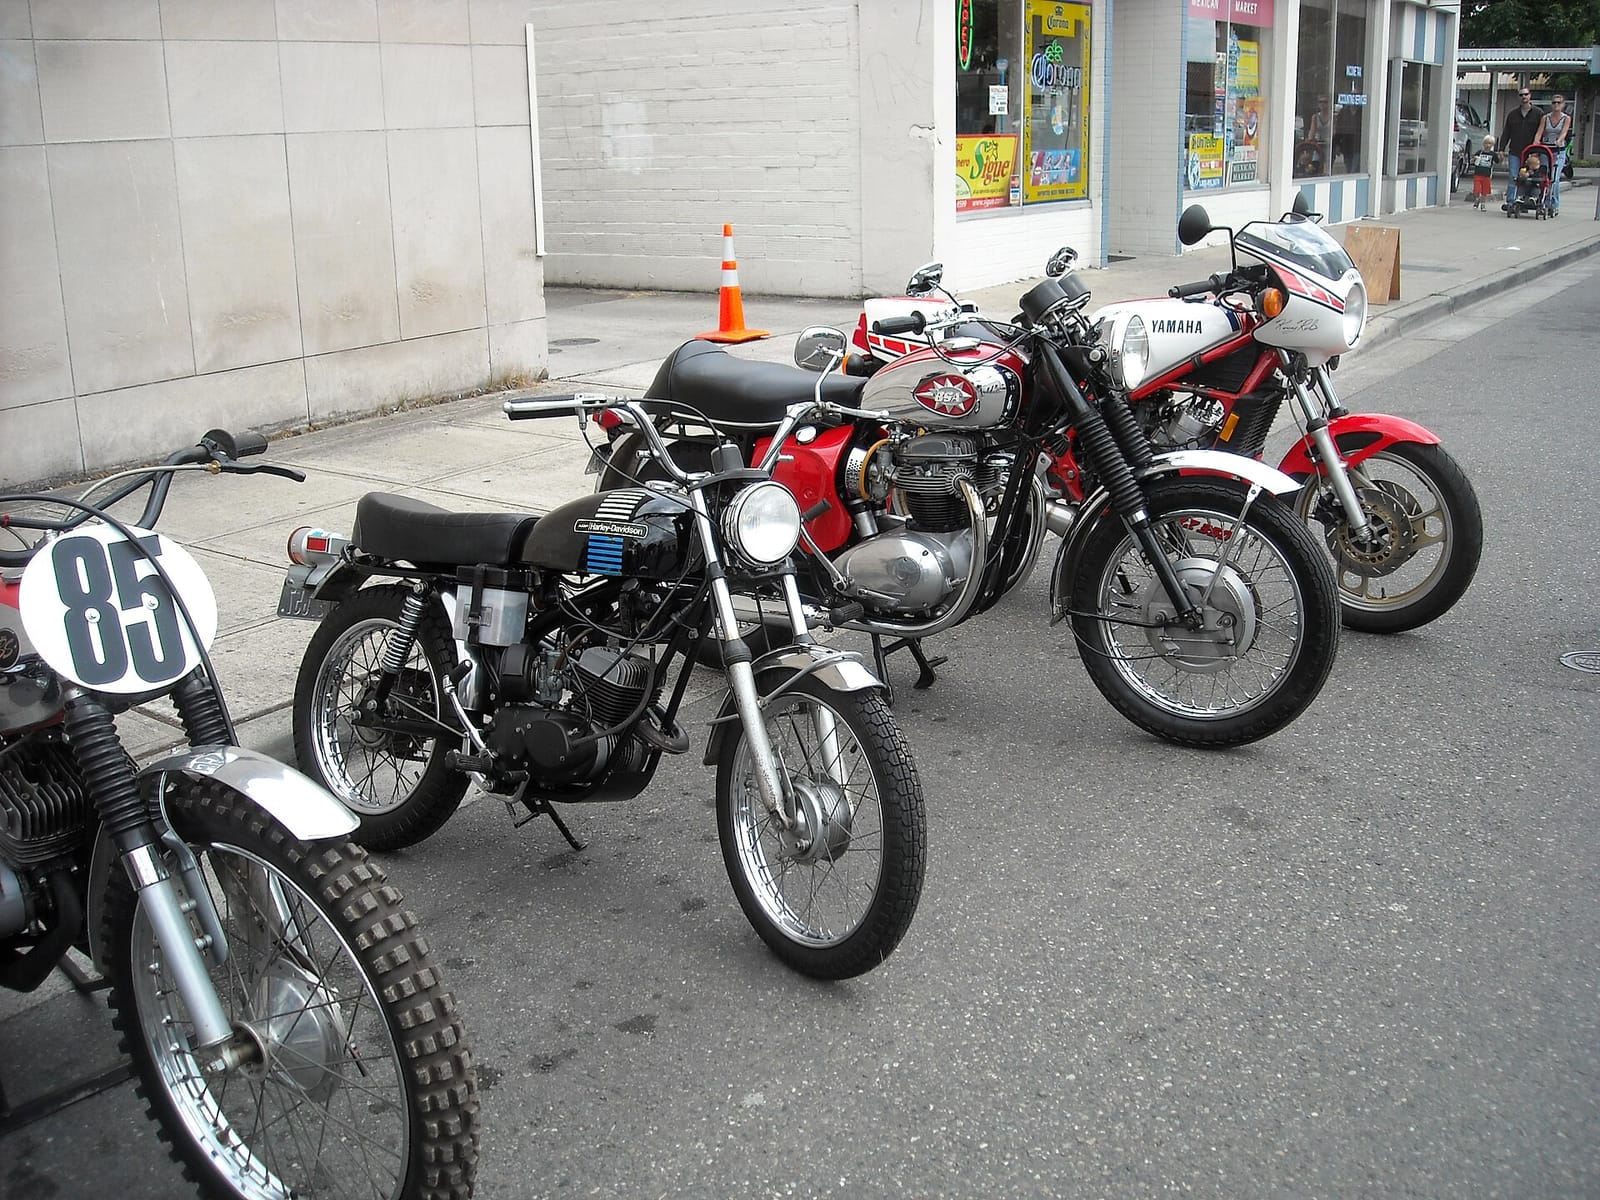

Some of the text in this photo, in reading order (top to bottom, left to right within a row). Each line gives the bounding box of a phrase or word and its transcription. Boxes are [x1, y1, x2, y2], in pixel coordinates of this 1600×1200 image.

[1235, 1, 1258, 15] MARKET
[1047, 14, 1069, 30] Corona
[1031, 53, 1082, 92] Corona
[970, 140, 1010, 186] Sigue
[1152, 319, 1202, 334] YAMAHA
[935, 391, 960, 403] BSA
[590, 522, 643, 536] Harley-Davidson
[51, 534, 187, 685] 85
